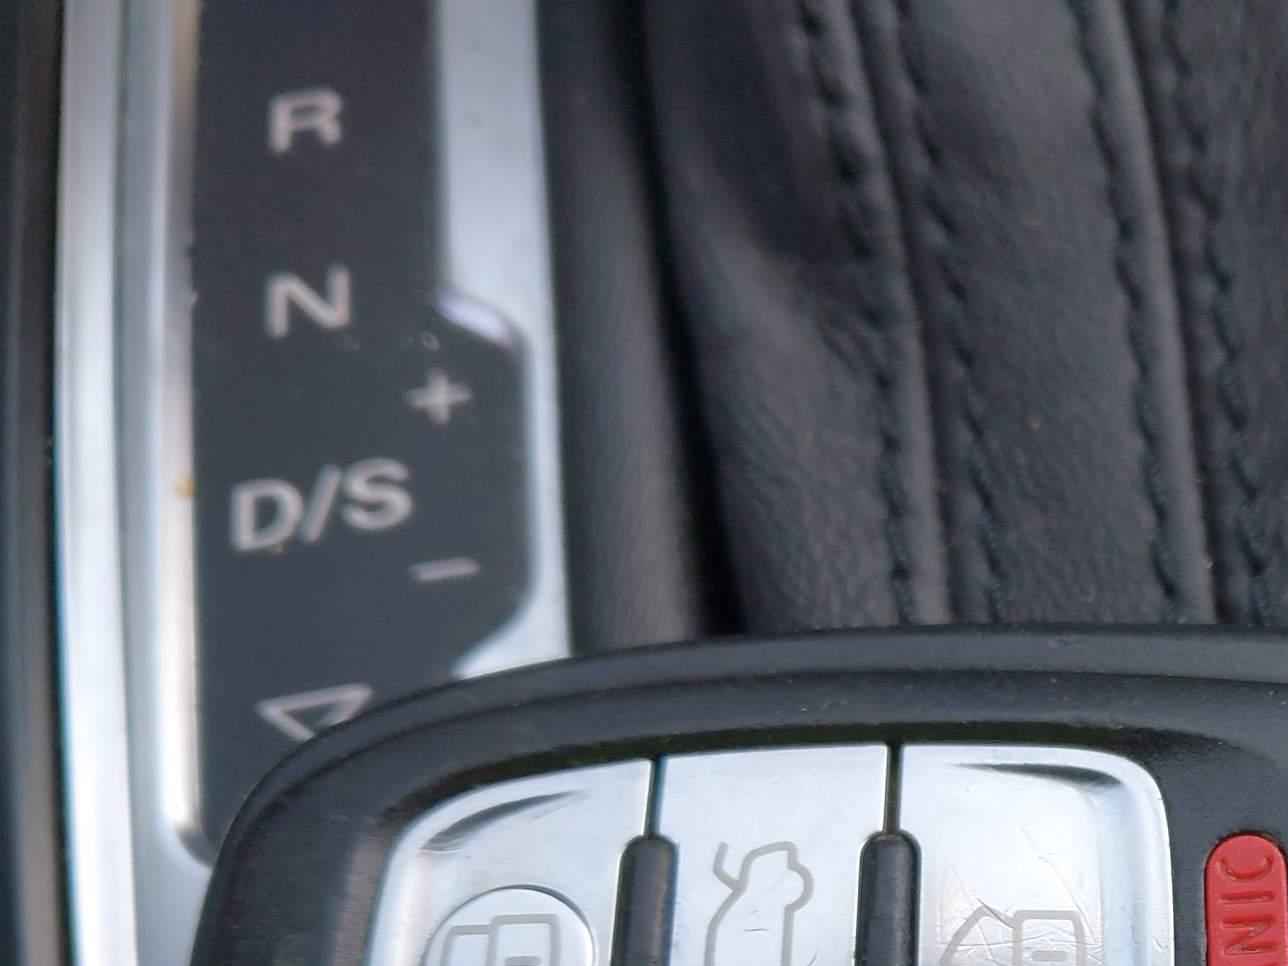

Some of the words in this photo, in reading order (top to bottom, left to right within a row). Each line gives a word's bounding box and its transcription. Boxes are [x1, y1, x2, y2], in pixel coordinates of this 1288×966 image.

[270, 88, 342, 152] R
[266, 265, 351, 337] N
[230, 456, 413, 552] D/S
